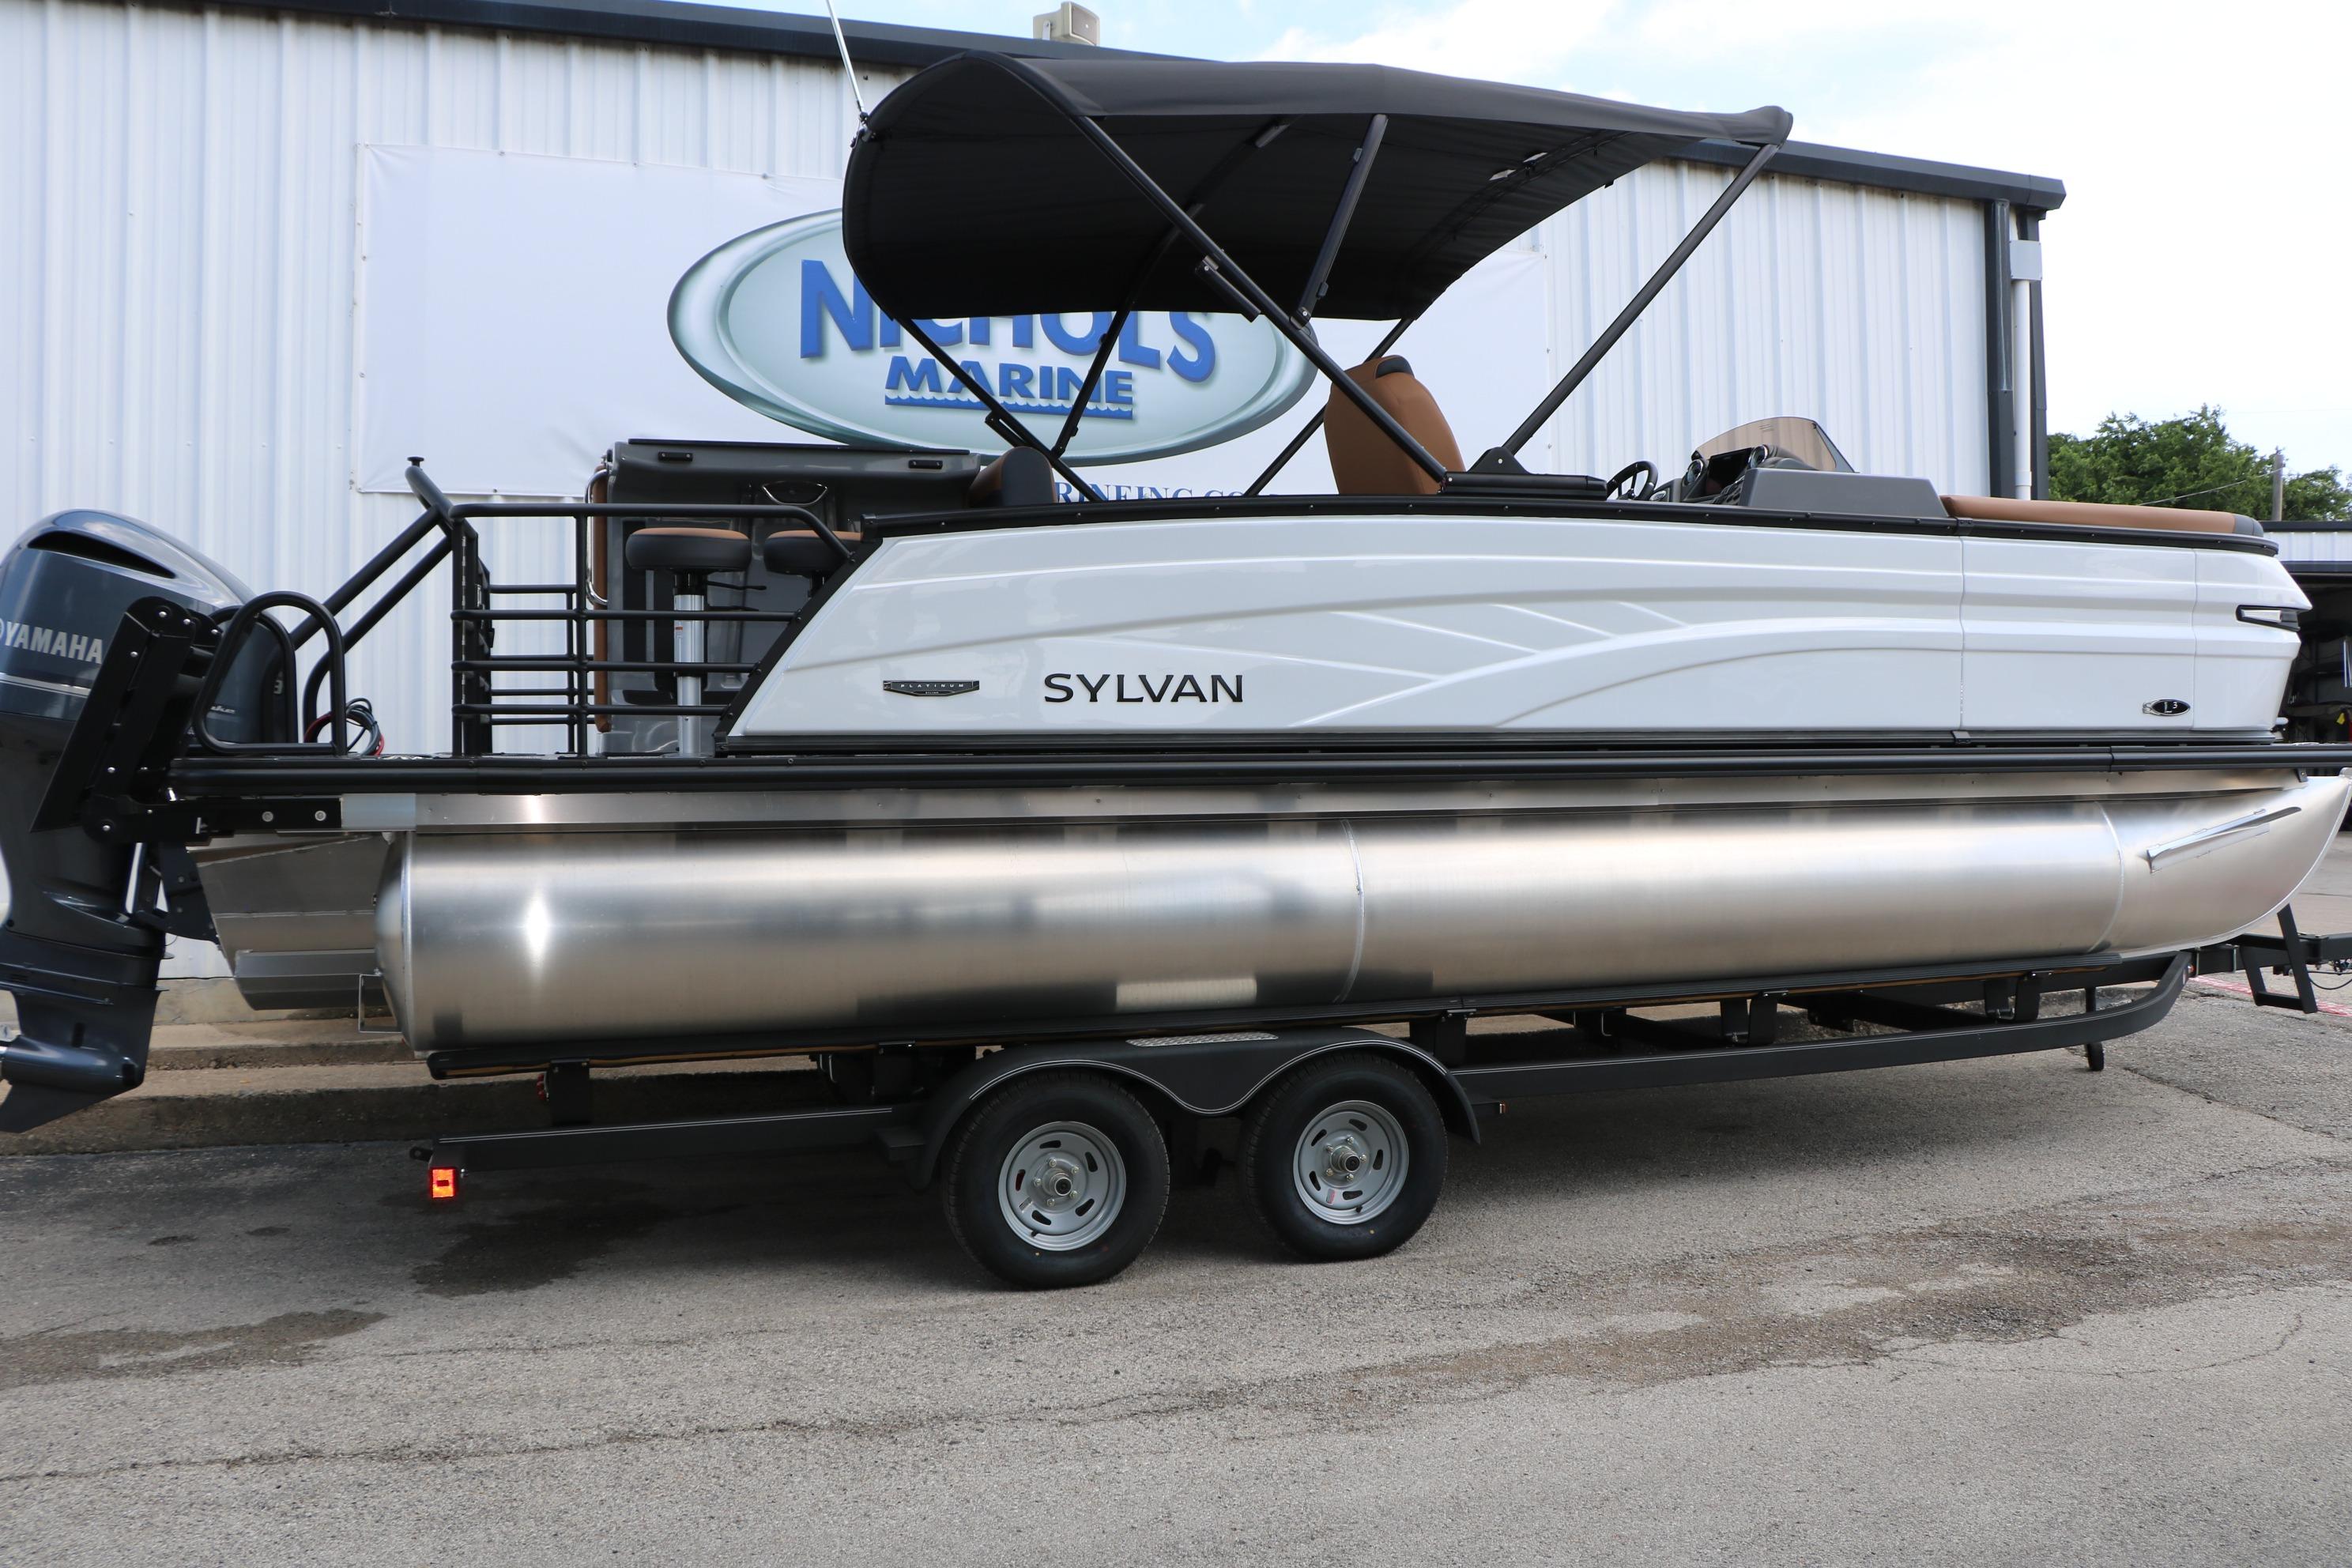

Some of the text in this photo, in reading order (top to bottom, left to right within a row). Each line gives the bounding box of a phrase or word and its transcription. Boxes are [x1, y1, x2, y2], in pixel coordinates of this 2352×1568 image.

[884, 356, 1133, 405] MARINE
[5, 621, 103, 665] YAMAHA
[1044, 673, 1243, 703] SYLVAN
